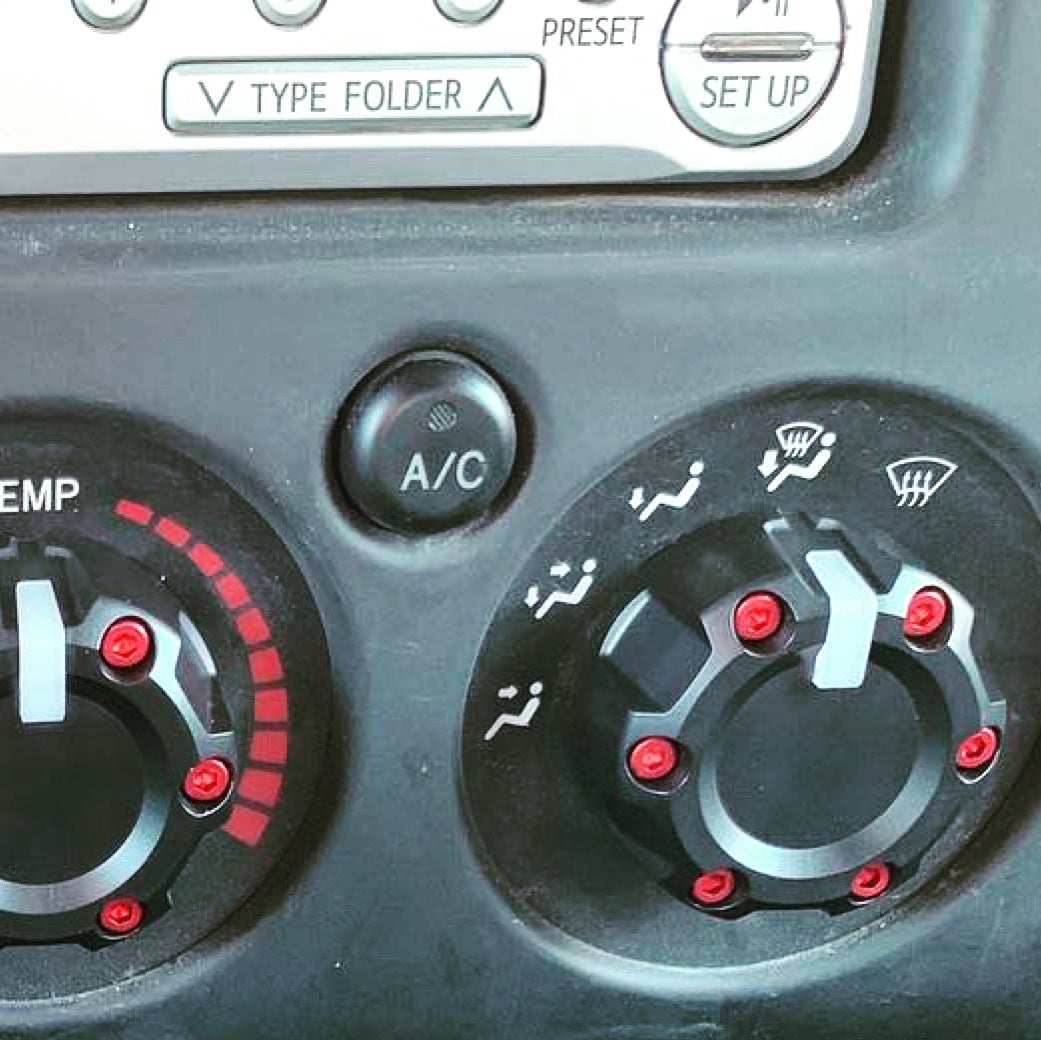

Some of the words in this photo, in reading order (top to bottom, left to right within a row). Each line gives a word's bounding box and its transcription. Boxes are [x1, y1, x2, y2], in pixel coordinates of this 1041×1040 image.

[542, 16, 645, 46] PRESET
[251, 82, 327, 113] TYPE
[345, 80, 462, 112] FOLDER
[700, 76, 760, 108] SET
[767, 75, 810, 107] UP
[400, 451, 486, 491] A/C
